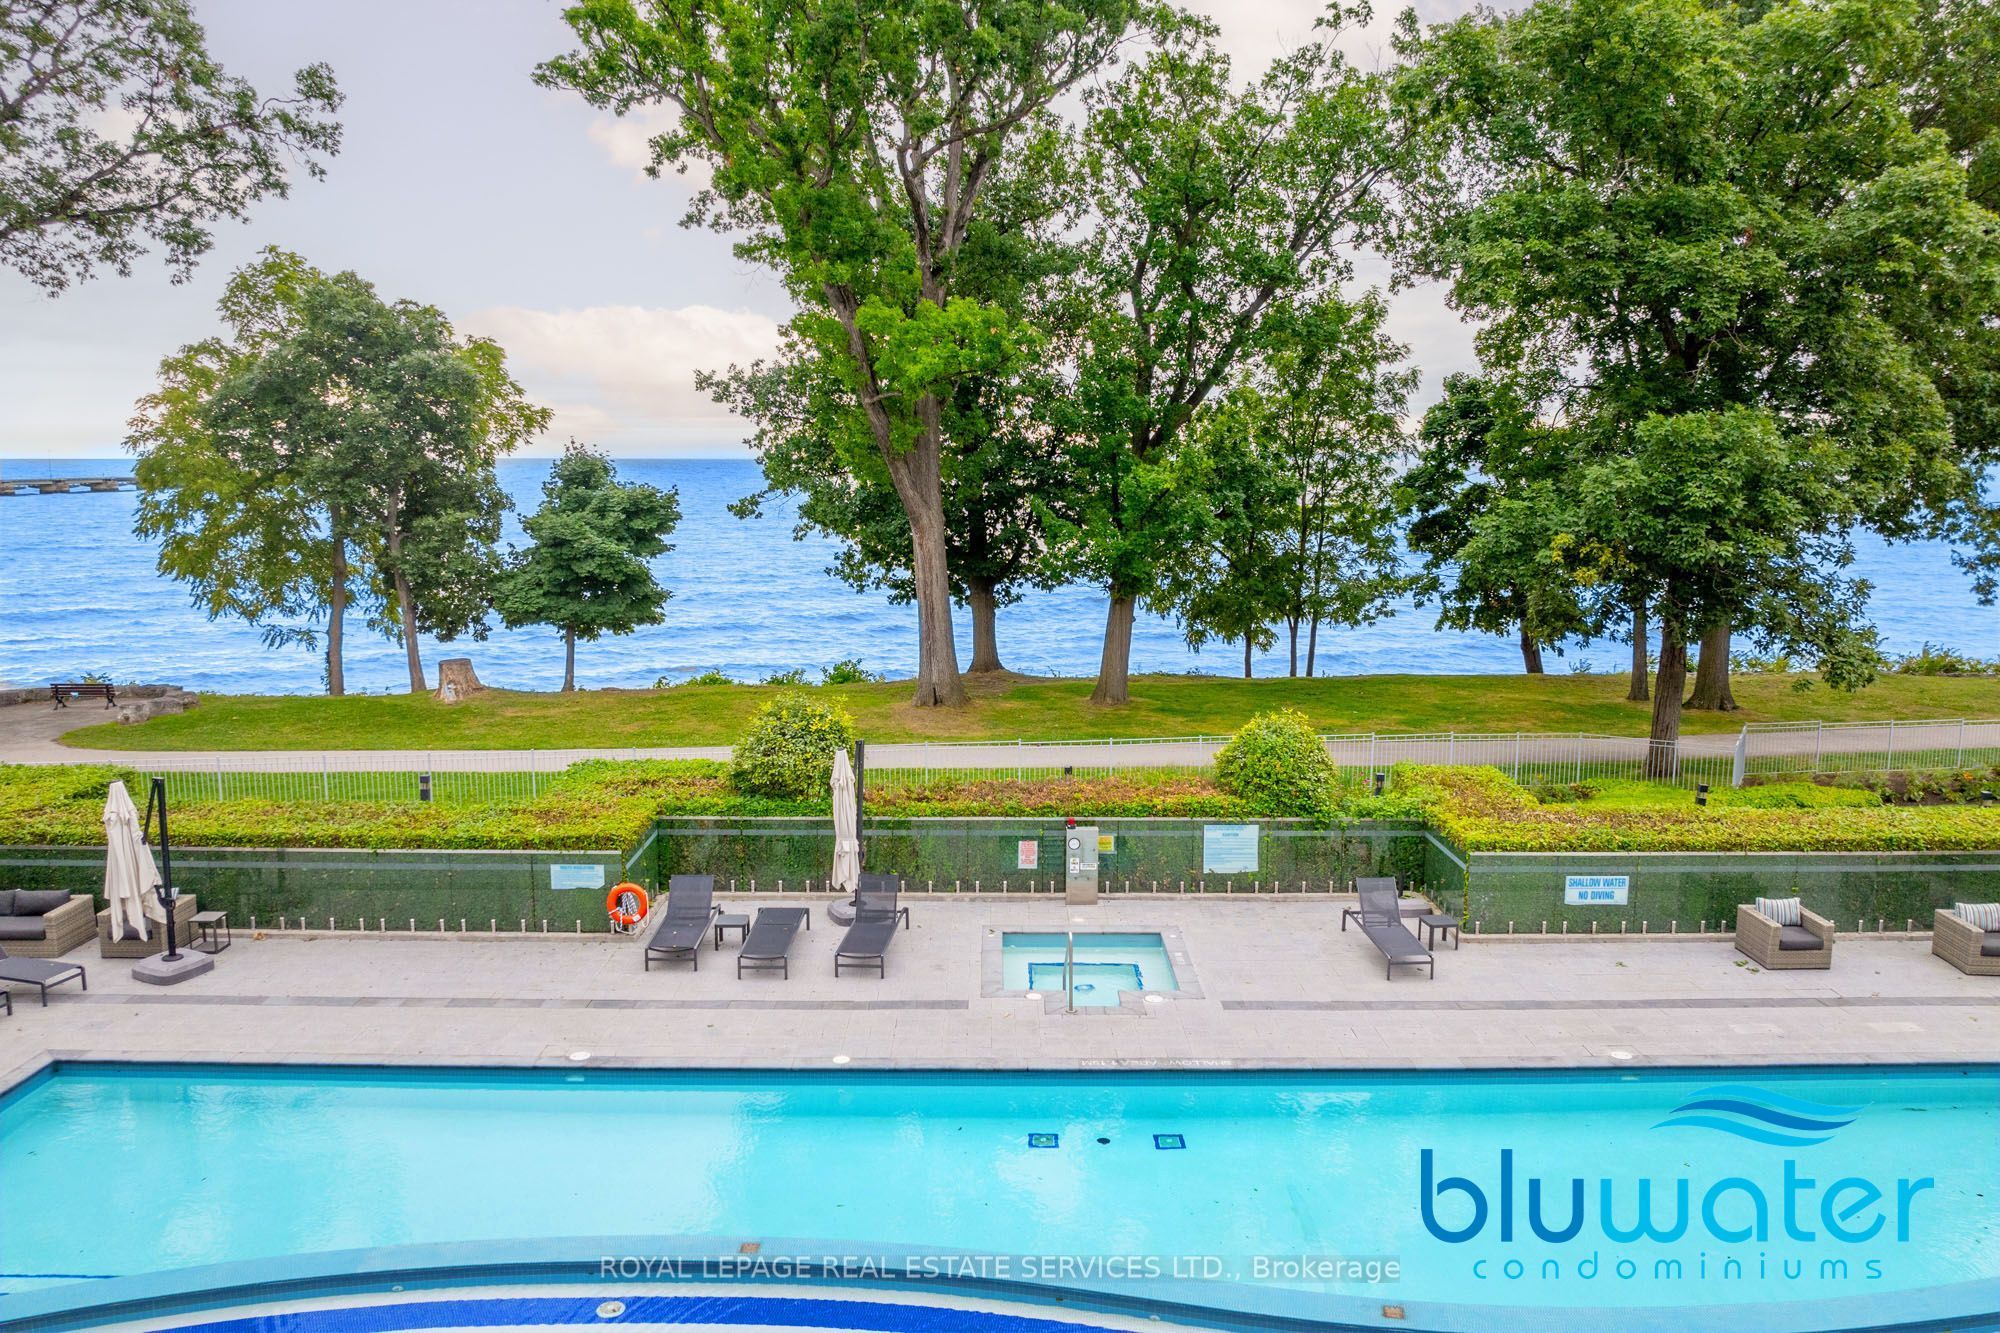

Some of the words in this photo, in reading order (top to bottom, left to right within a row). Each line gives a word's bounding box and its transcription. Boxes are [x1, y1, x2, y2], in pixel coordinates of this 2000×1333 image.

[1568, 878, 1600, 887] SHALLOW
[1603, 878, 1626, 887] WATER
[1578, 891, 1588, 900] NO
[1591, 891, 1615, 900] DIVING
